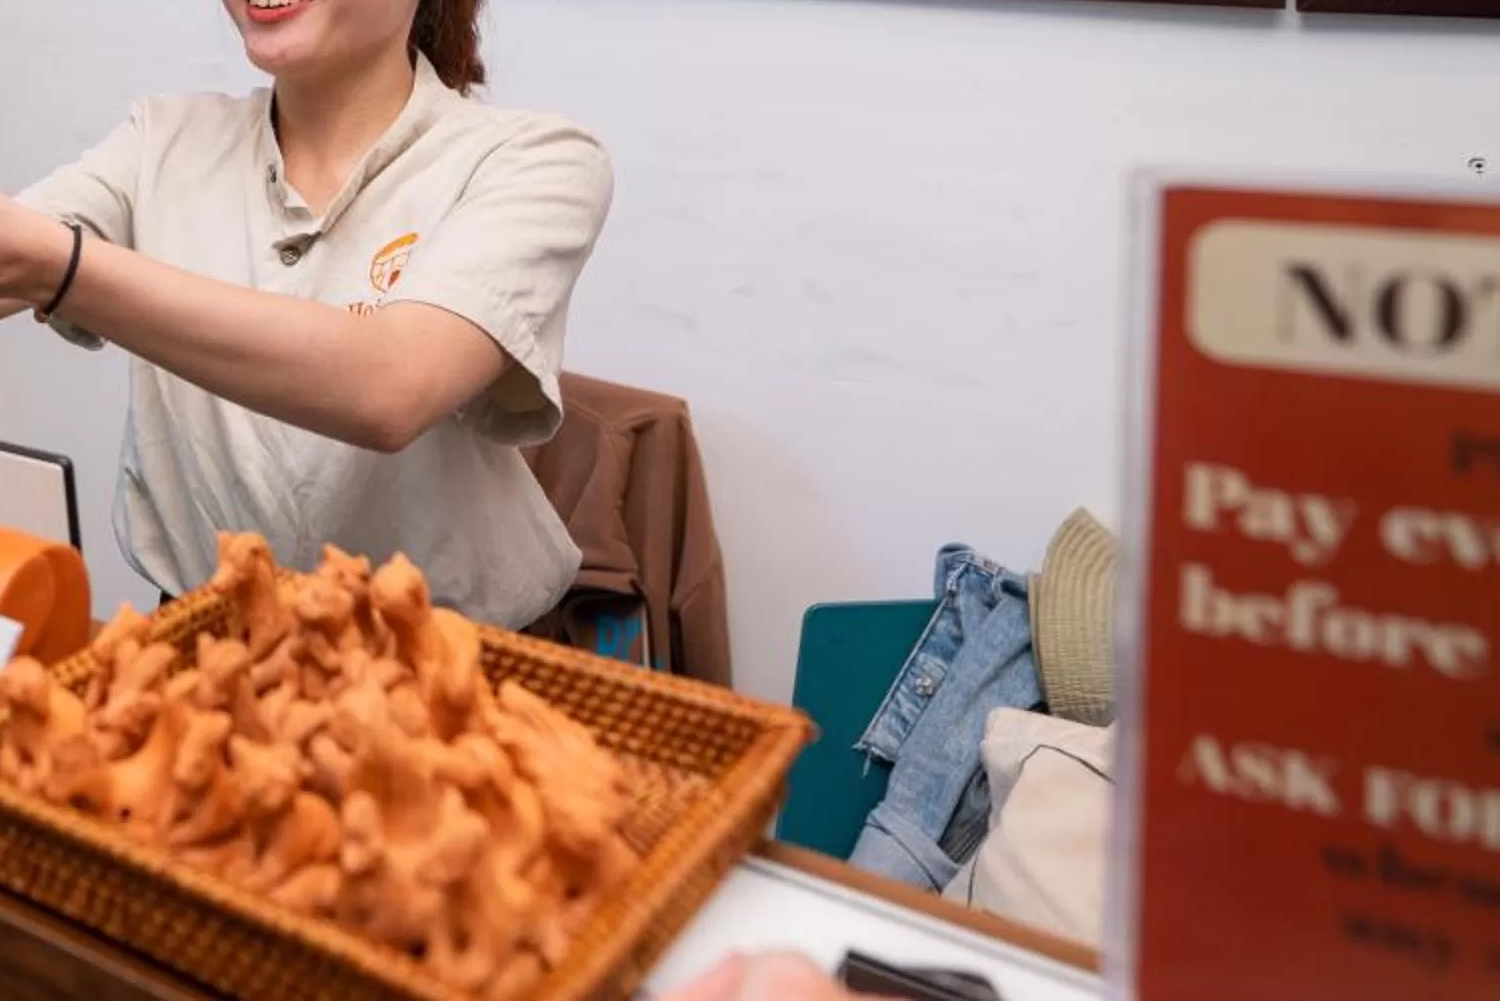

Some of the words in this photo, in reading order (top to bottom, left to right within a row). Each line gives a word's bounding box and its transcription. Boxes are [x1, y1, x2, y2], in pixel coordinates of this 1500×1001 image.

[1276, 259, 1500, 357] NO
[1182, 461, 1360, 569] Pay
[1178, 559, 1492, 681] before
[1175, 731, 1342, 821] ASK
